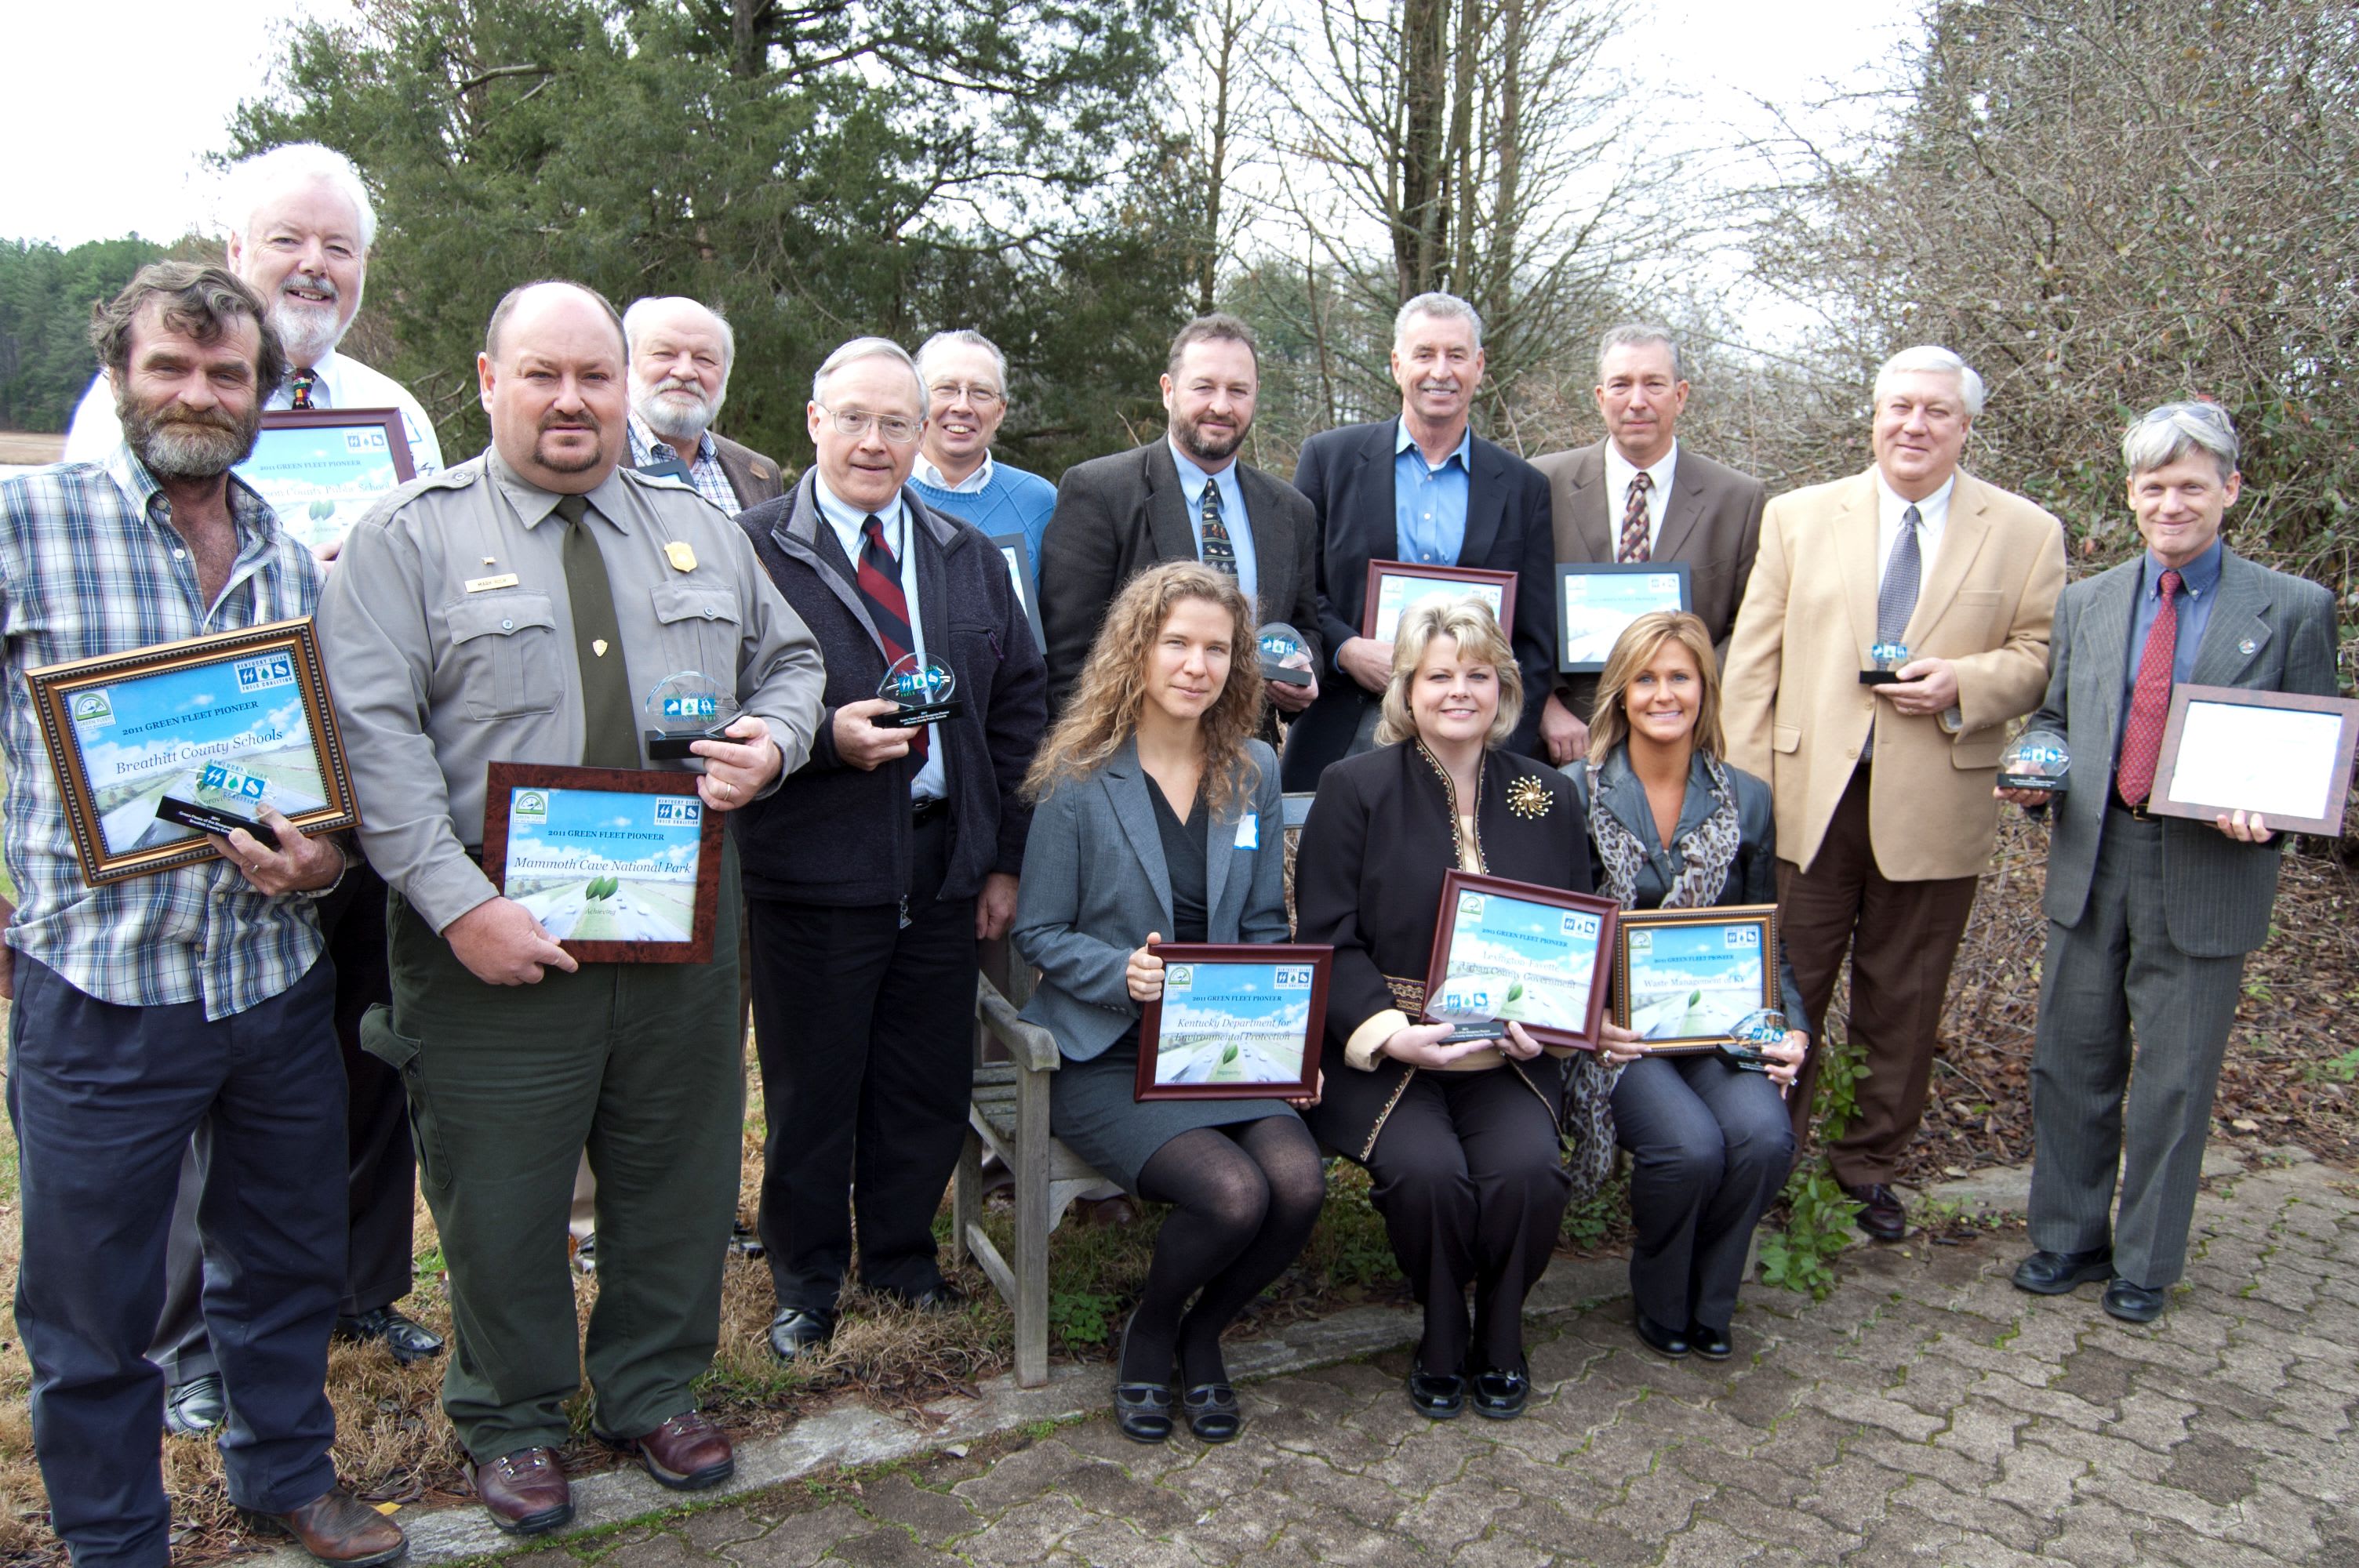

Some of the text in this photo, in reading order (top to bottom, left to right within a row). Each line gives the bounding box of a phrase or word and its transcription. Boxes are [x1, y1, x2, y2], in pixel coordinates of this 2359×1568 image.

[329, 459, 362, 468] PIONEER
[122, 726, 143, 735] 2011
[145, 717, 180, 731] GREEN
[183, 710, 213, 723] FLEET
[214, 700, 260, 716] PIONEER
[116, 728, 282, 774] Breathitt County Schools
[567, 829, 598, 838] GREEN
[599, 831, 626, 840] FLEET
[627, 832, 664, 841] PIONEER
[514, 857, 692, 873] Mammoth Cave National Park
[1496, 930, 1518, 939] GREEN
[1519, 934, 1539, 942] FLEET
[1539, 938, 1568, 948] PIONEER
[1523, 972, 1576, 989] Government
[1644, 978, 1669, 988] Waste
[1670, 977, 1721, 987] Management
[1177, 1018, 1292, 1029] Kentucky Department for
[1175, 1032, 1291, 1042] Environmental Protection
